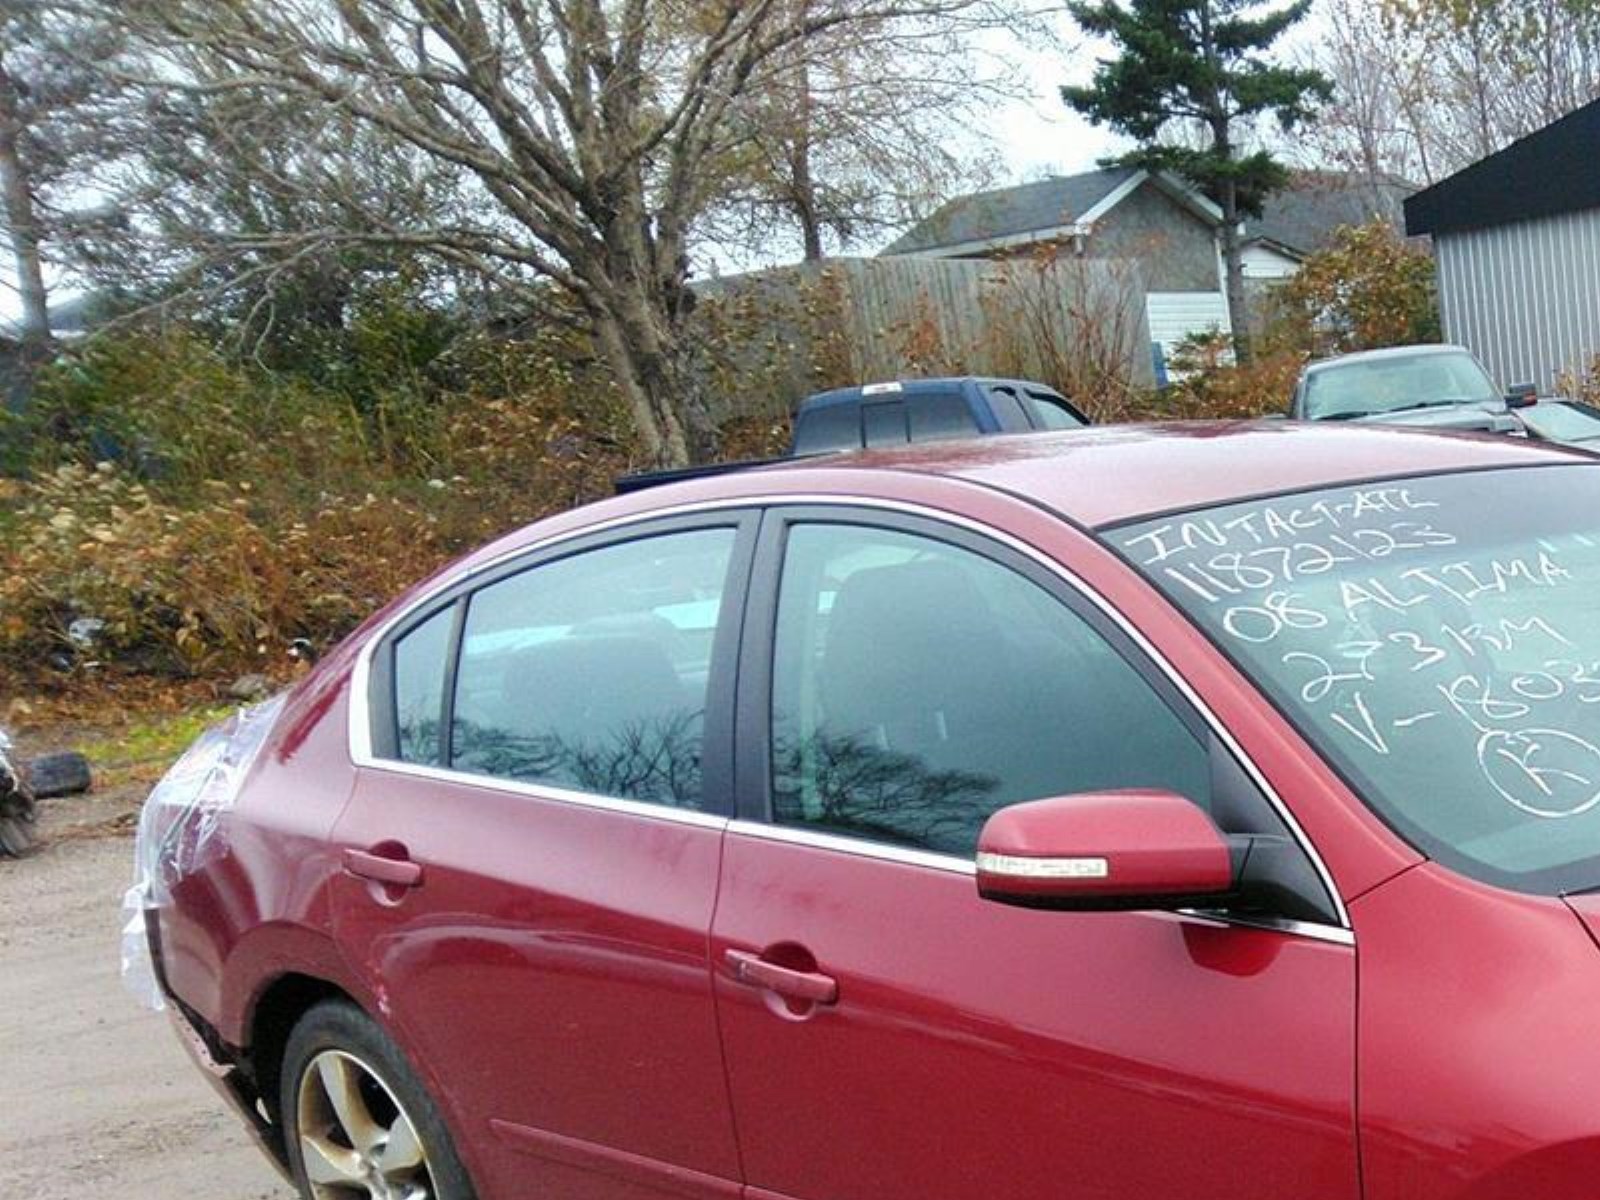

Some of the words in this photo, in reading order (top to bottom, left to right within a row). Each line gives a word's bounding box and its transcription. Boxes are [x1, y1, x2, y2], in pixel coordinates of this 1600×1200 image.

[1164, 522, 1457, 602] 11872123
[1223, 590, 1328, 642] 08
[1339, 552, 1574, 623] ALTIMA
